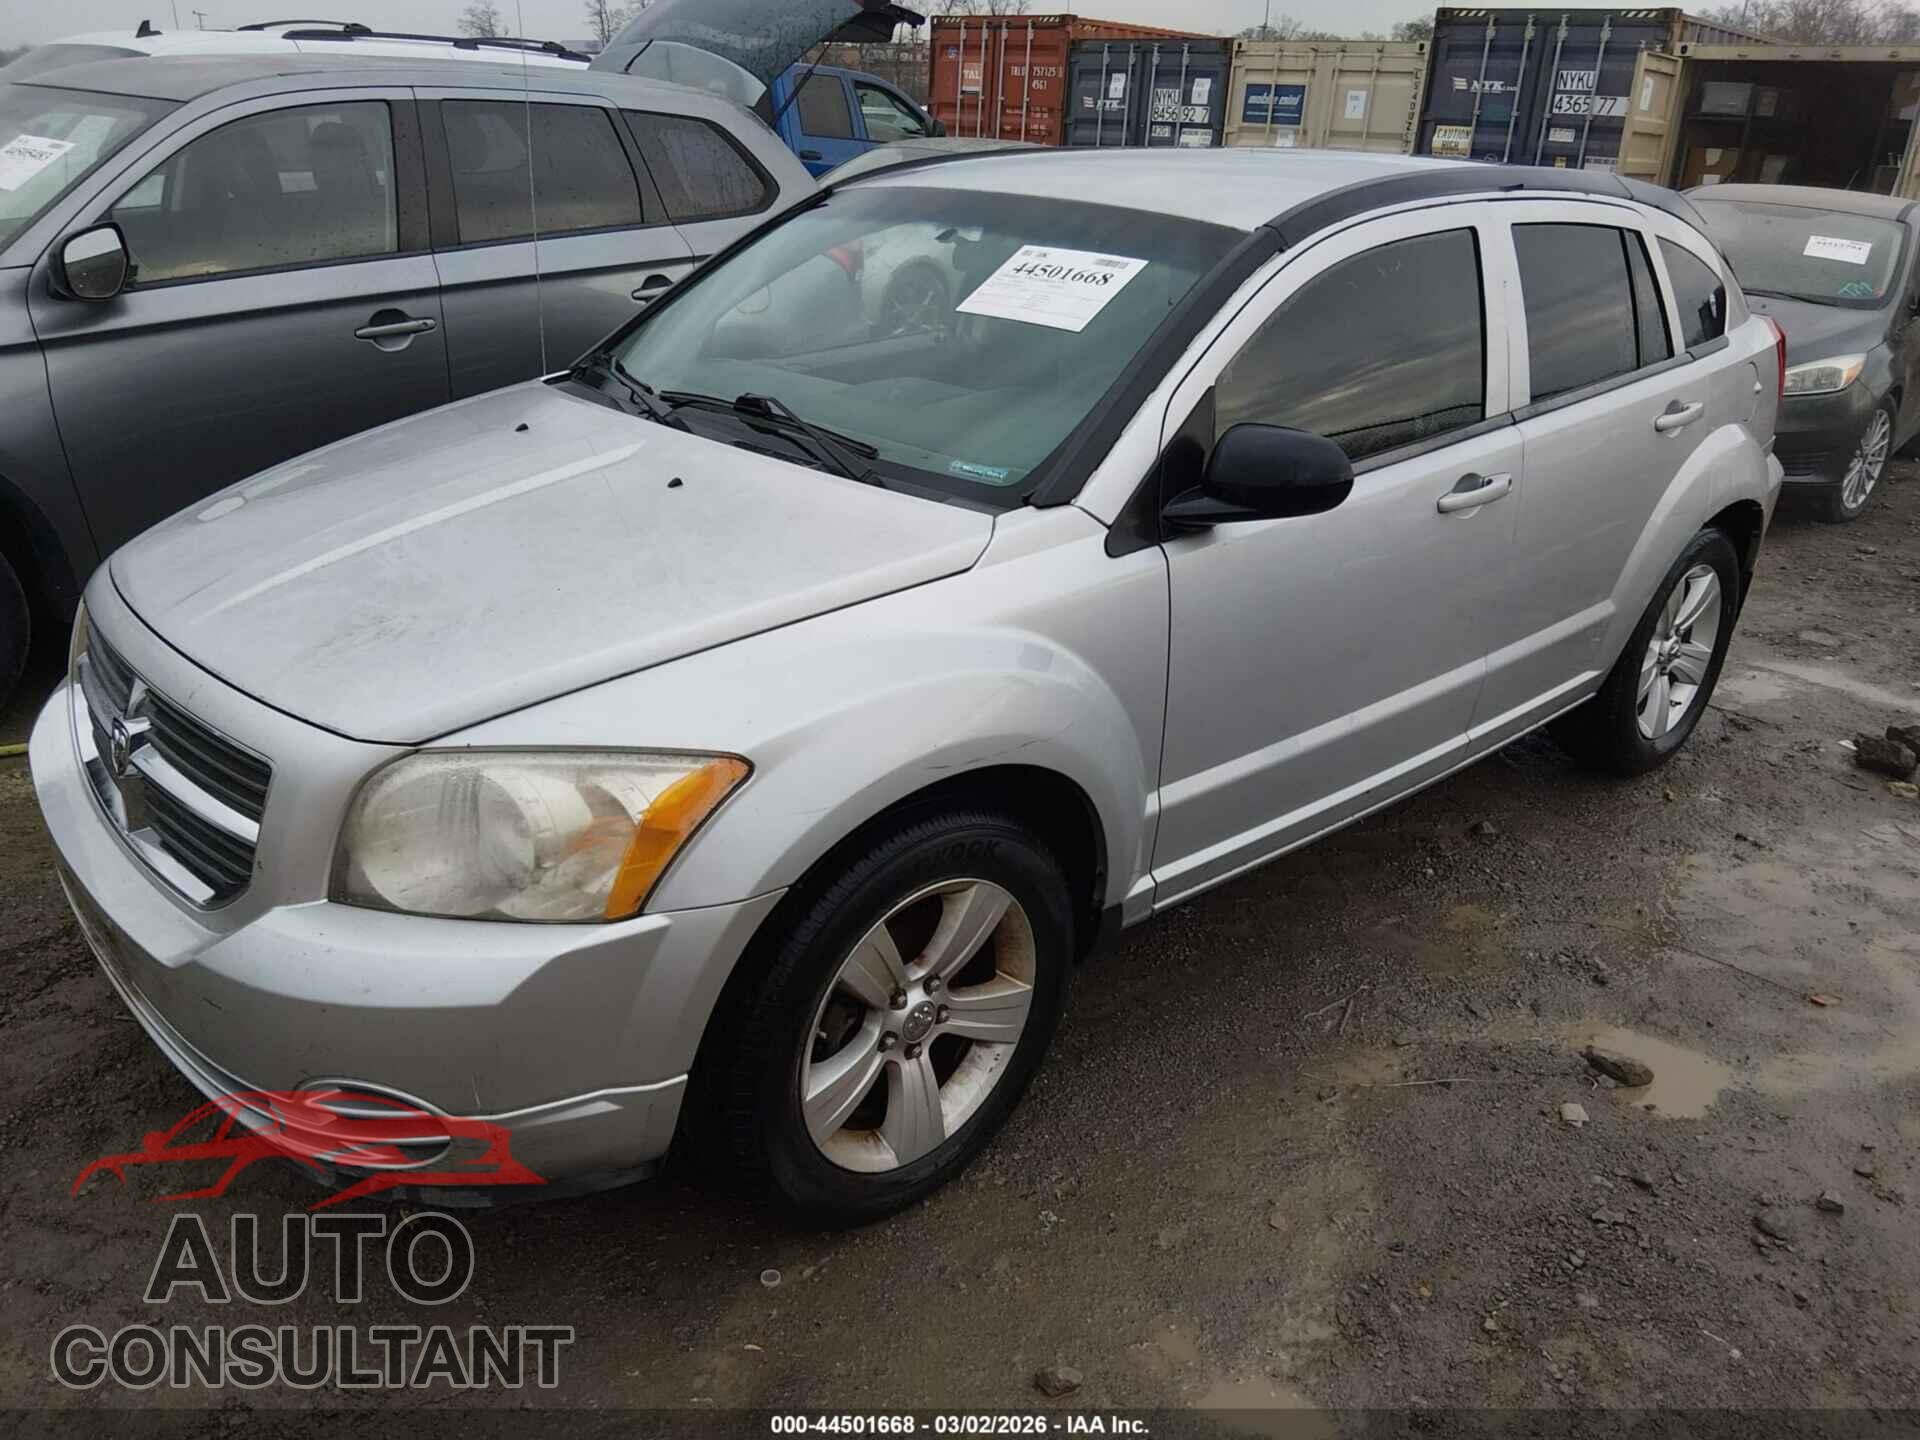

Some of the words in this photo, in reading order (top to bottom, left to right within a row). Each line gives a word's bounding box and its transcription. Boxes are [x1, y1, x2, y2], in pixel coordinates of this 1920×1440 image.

[963, 69, 980, 80] TAL
[1558, 71, 1594, 89] NYKU
[1472, 79, 1504, 92] NYK
[1154, 89, 1180, 105] NYKU
[1012, 261, 1114, 287] 44501668
